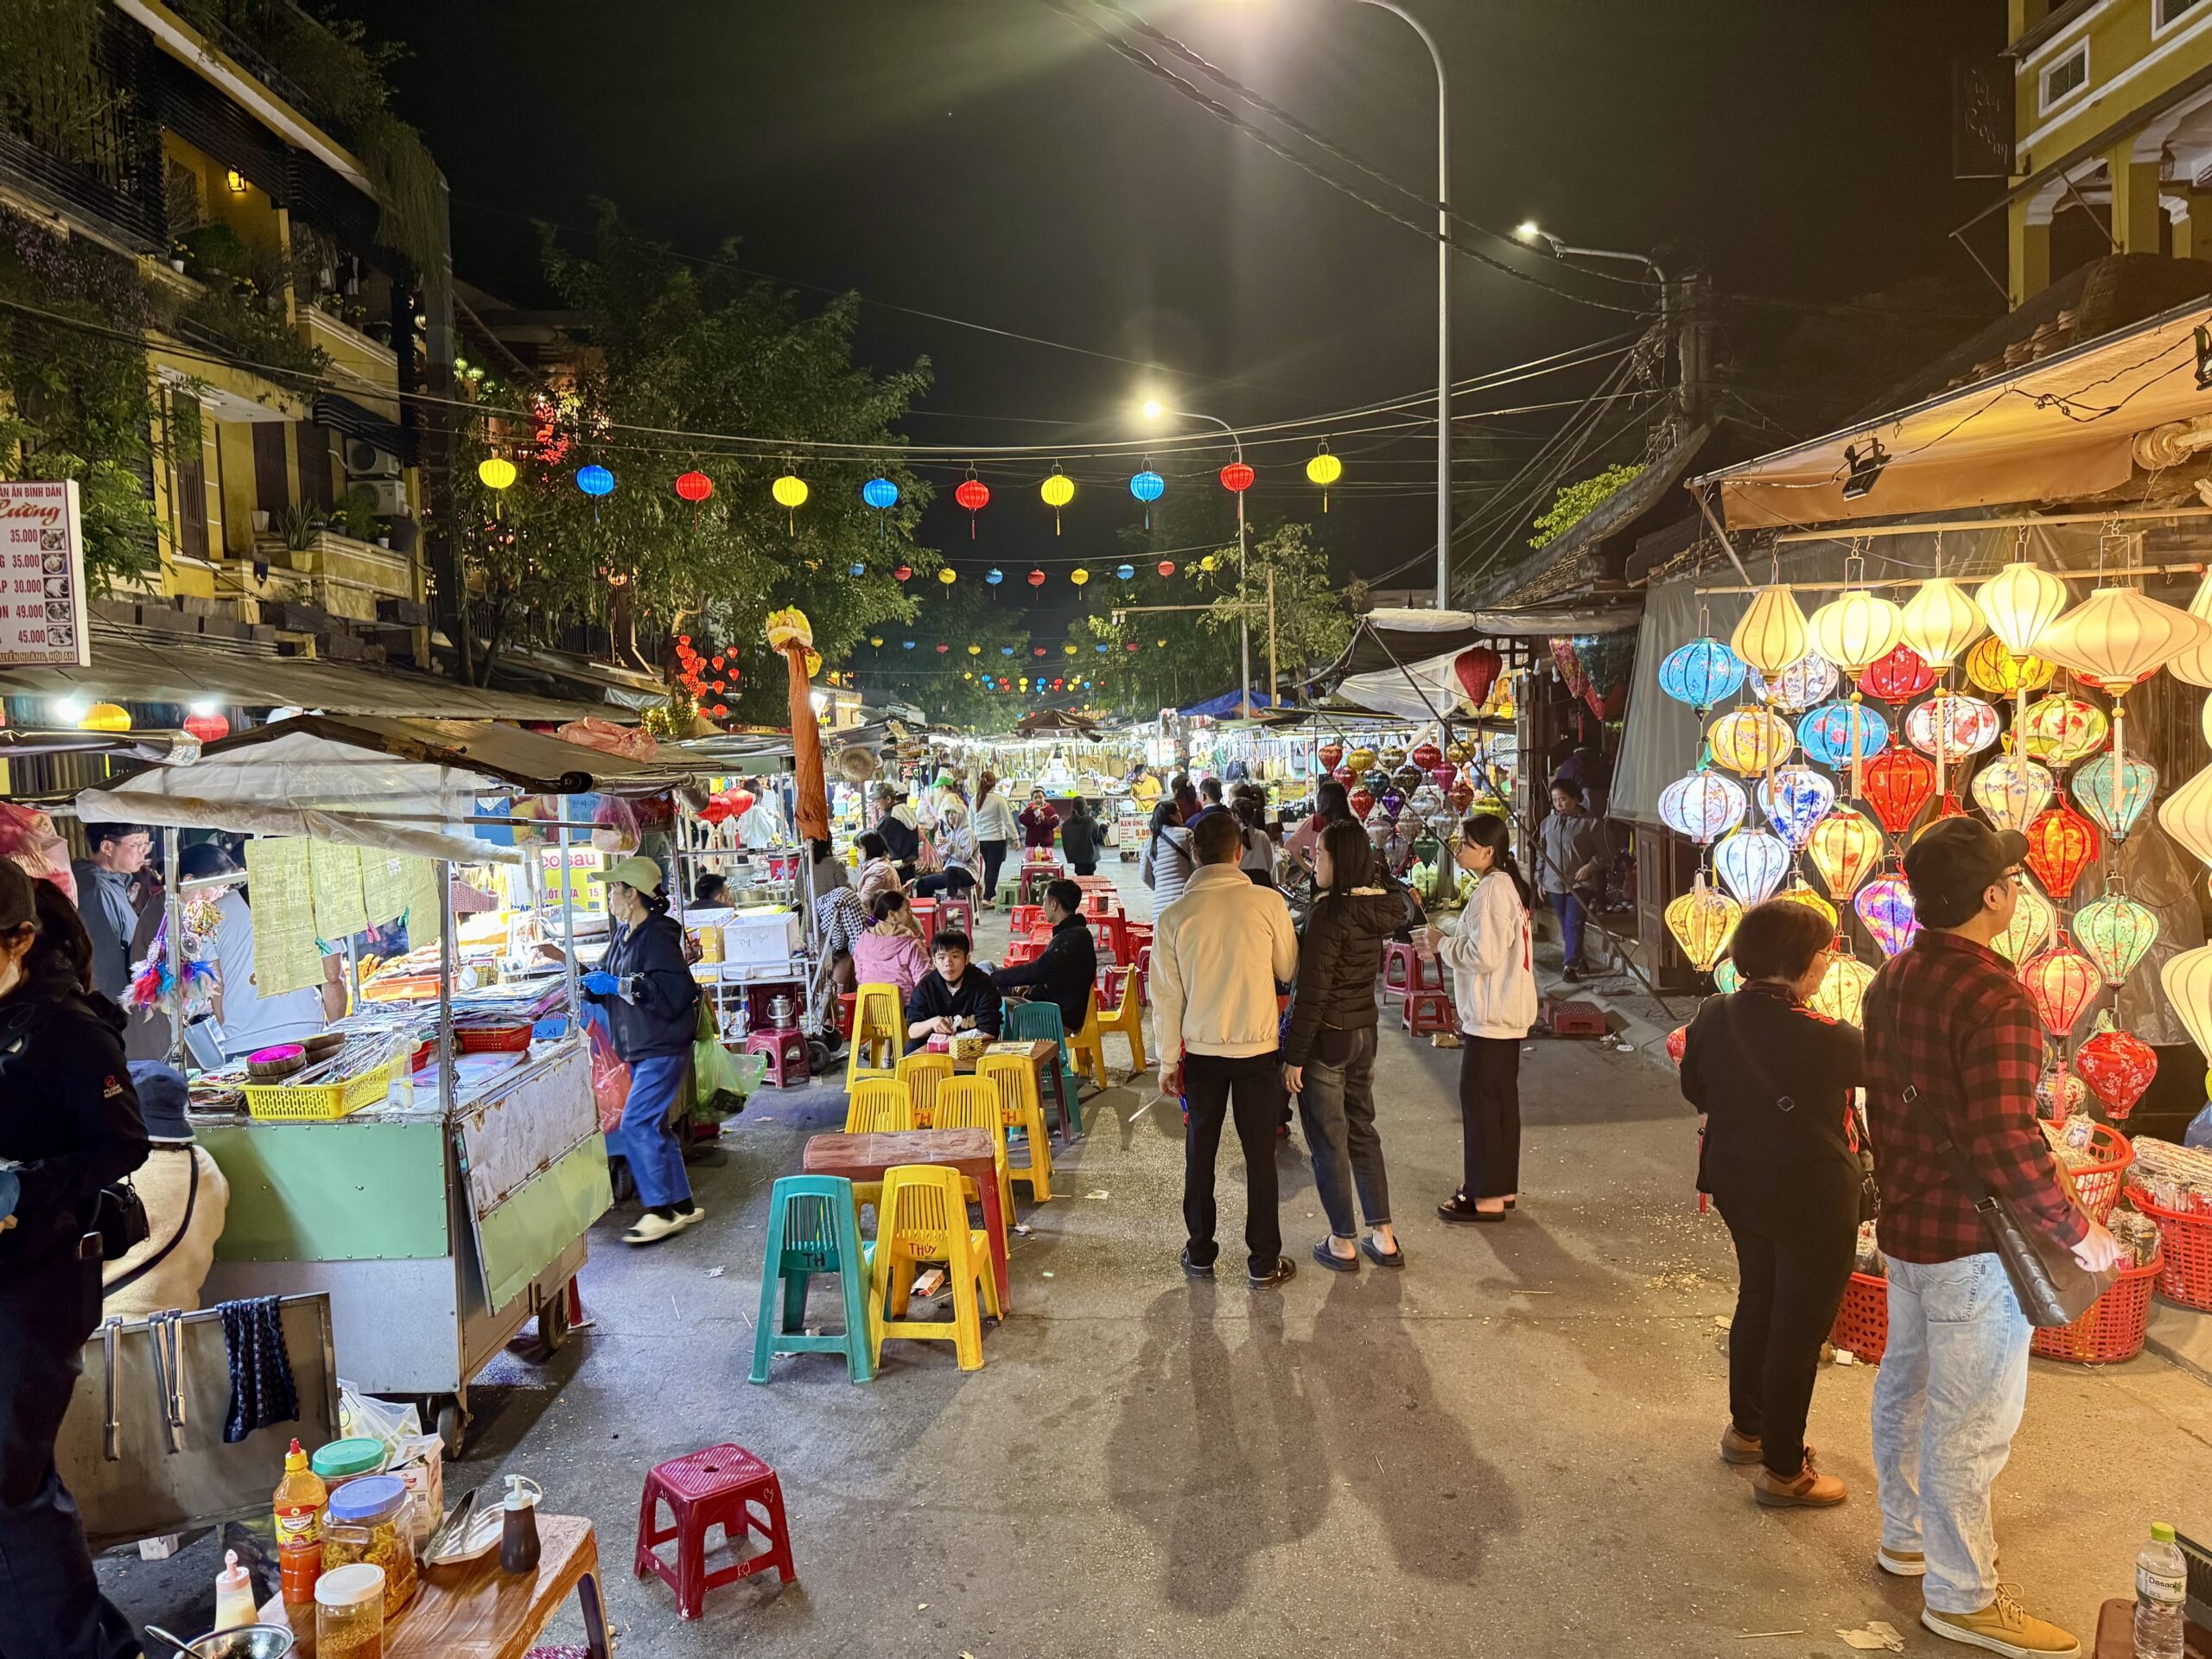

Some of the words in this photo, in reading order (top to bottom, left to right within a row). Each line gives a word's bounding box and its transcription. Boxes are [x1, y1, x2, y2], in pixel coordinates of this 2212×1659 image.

[10, 529, 38, 543] 35.000
[12, 554, 40, 568] 35.000
[14, 579, 41, 593] 30.000
[16, 605, 43, 618] 49.000
[18, 630, 45, 643] 45.000
